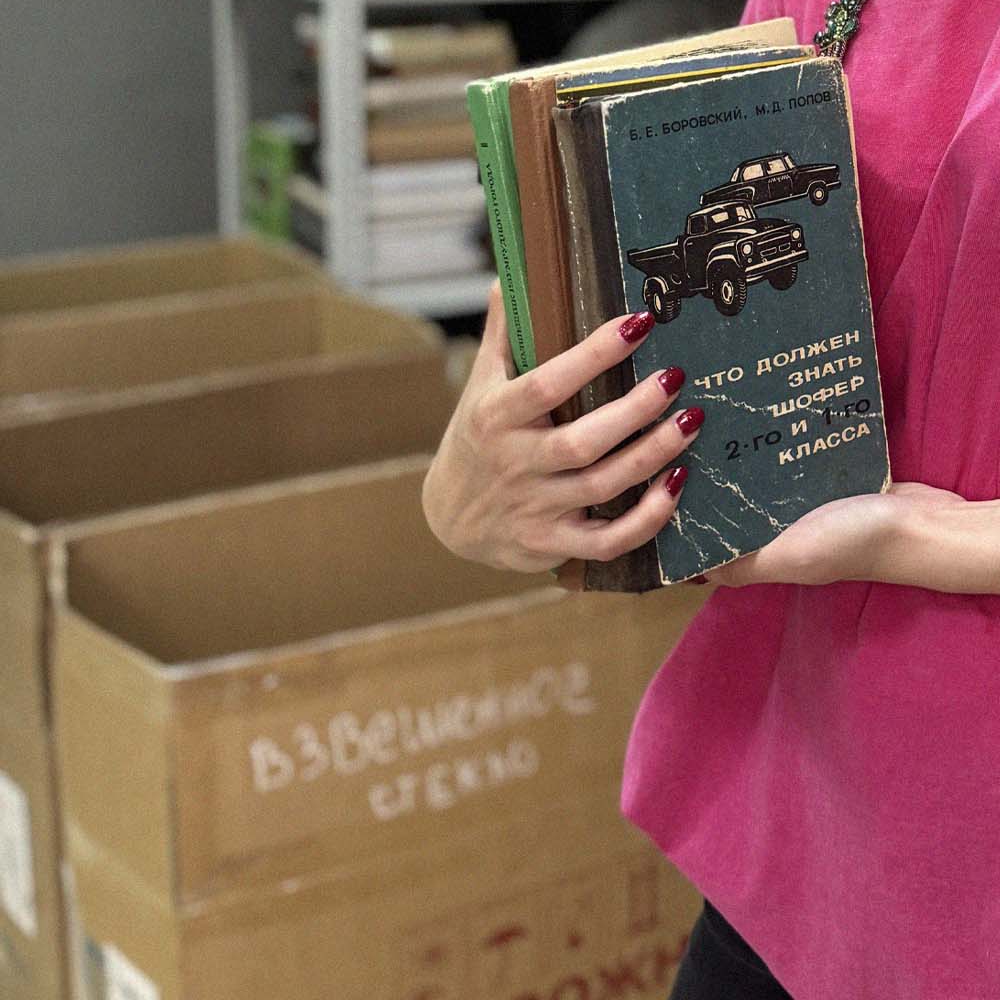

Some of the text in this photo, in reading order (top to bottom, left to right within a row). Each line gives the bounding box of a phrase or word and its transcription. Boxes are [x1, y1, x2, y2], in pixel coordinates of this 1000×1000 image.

[630, 128, 642, 141] Б.
[645, 126, 658, 139] Е.
[662, 106, 747, 135] БОРОВСКИЙ,
[788, 90, 831, 111] ПОПОВ
[694, 330, 859, 390] ЧТО ДОЛЖЕН
[787, 355, 863, 388] ЗНАТЬ
[767, 375, 865, 418] ШОФЕР
[779, 422, 871, 465] КЛАССА
[791, 419, 808, 437] И
